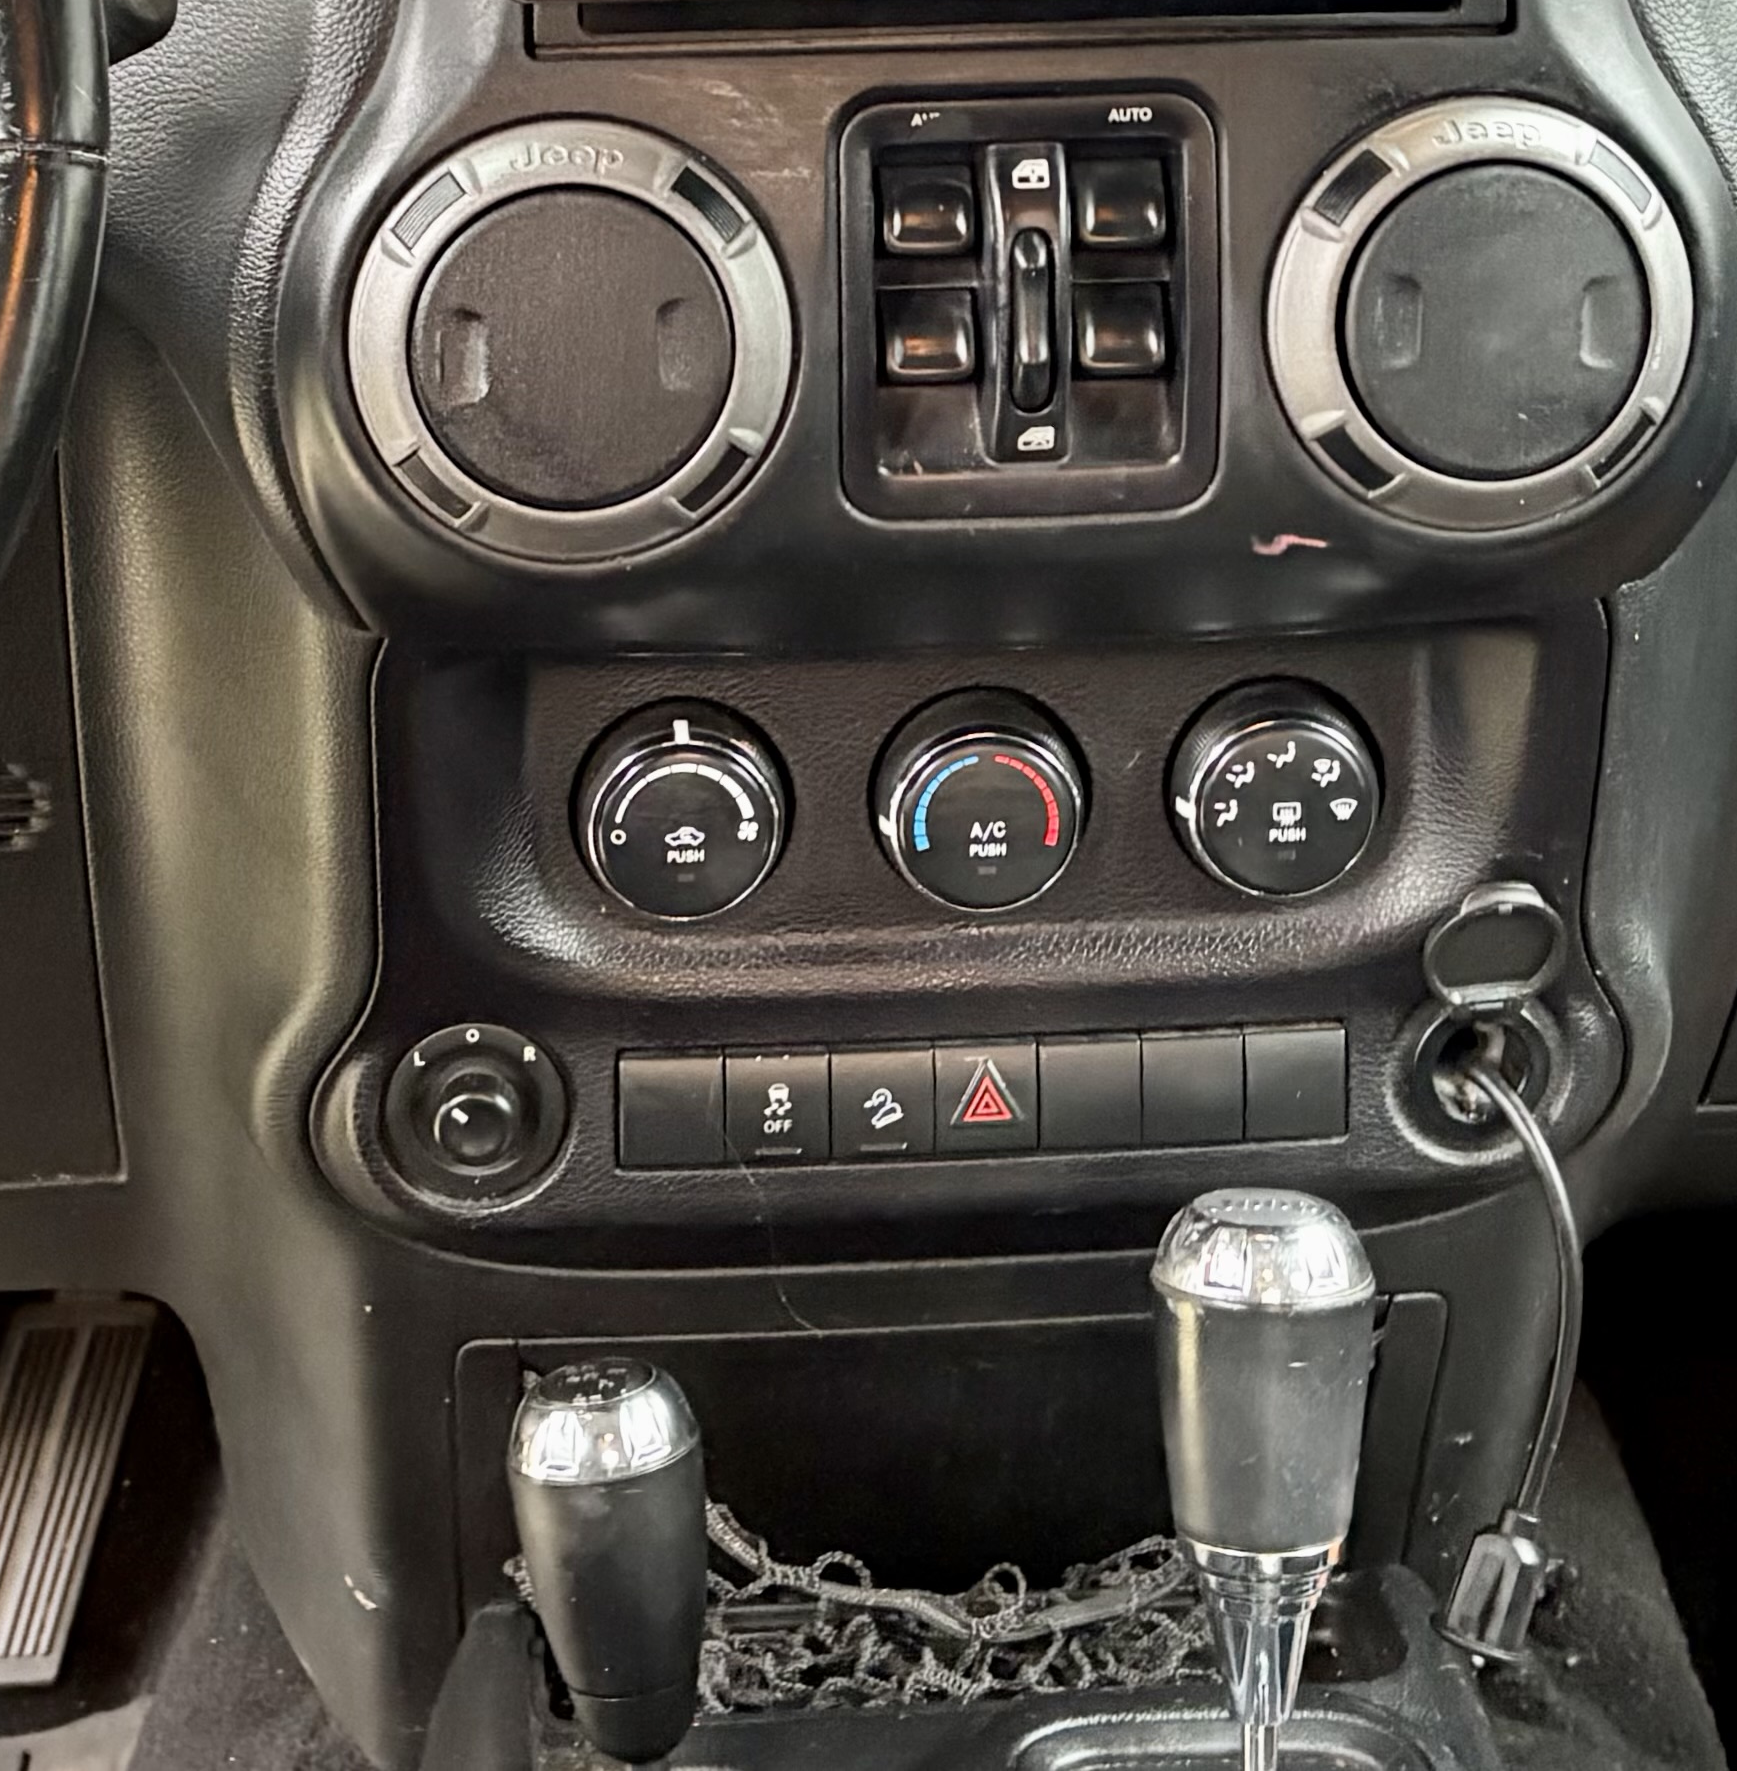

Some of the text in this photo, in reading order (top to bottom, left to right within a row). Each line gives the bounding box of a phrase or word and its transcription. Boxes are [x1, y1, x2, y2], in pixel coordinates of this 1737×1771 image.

[1108, 106, 1152, 123] AUTO
[1432, 118, 1545, 148] Jeep
[509, 143, 624, 175] Jeep
[970, 820, 1007, 842] A/C
[1268, 828, 1306, 843] PUSH
[666, 848, 705, 864] PUSH
[969, 843, 1007, 858] PUSH
[414, 1051, 426, 1066] L
[523, 1047, 537, 1063] R
[763, 1119, 793, 1134] OFF
